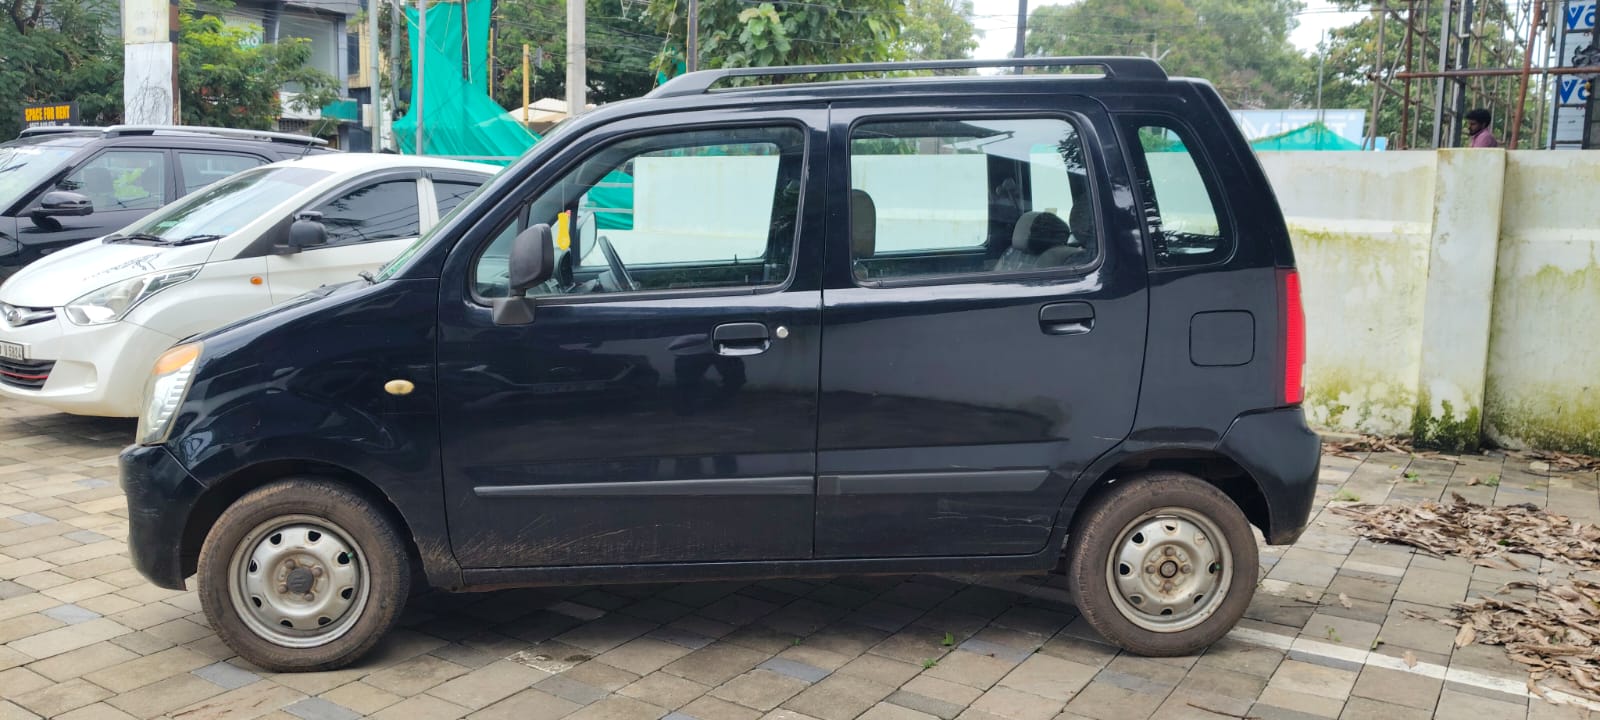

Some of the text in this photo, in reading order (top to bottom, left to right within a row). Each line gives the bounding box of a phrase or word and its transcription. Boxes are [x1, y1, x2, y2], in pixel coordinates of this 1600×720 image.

[25, 104, 70, 122] SPACE FOR RENT
